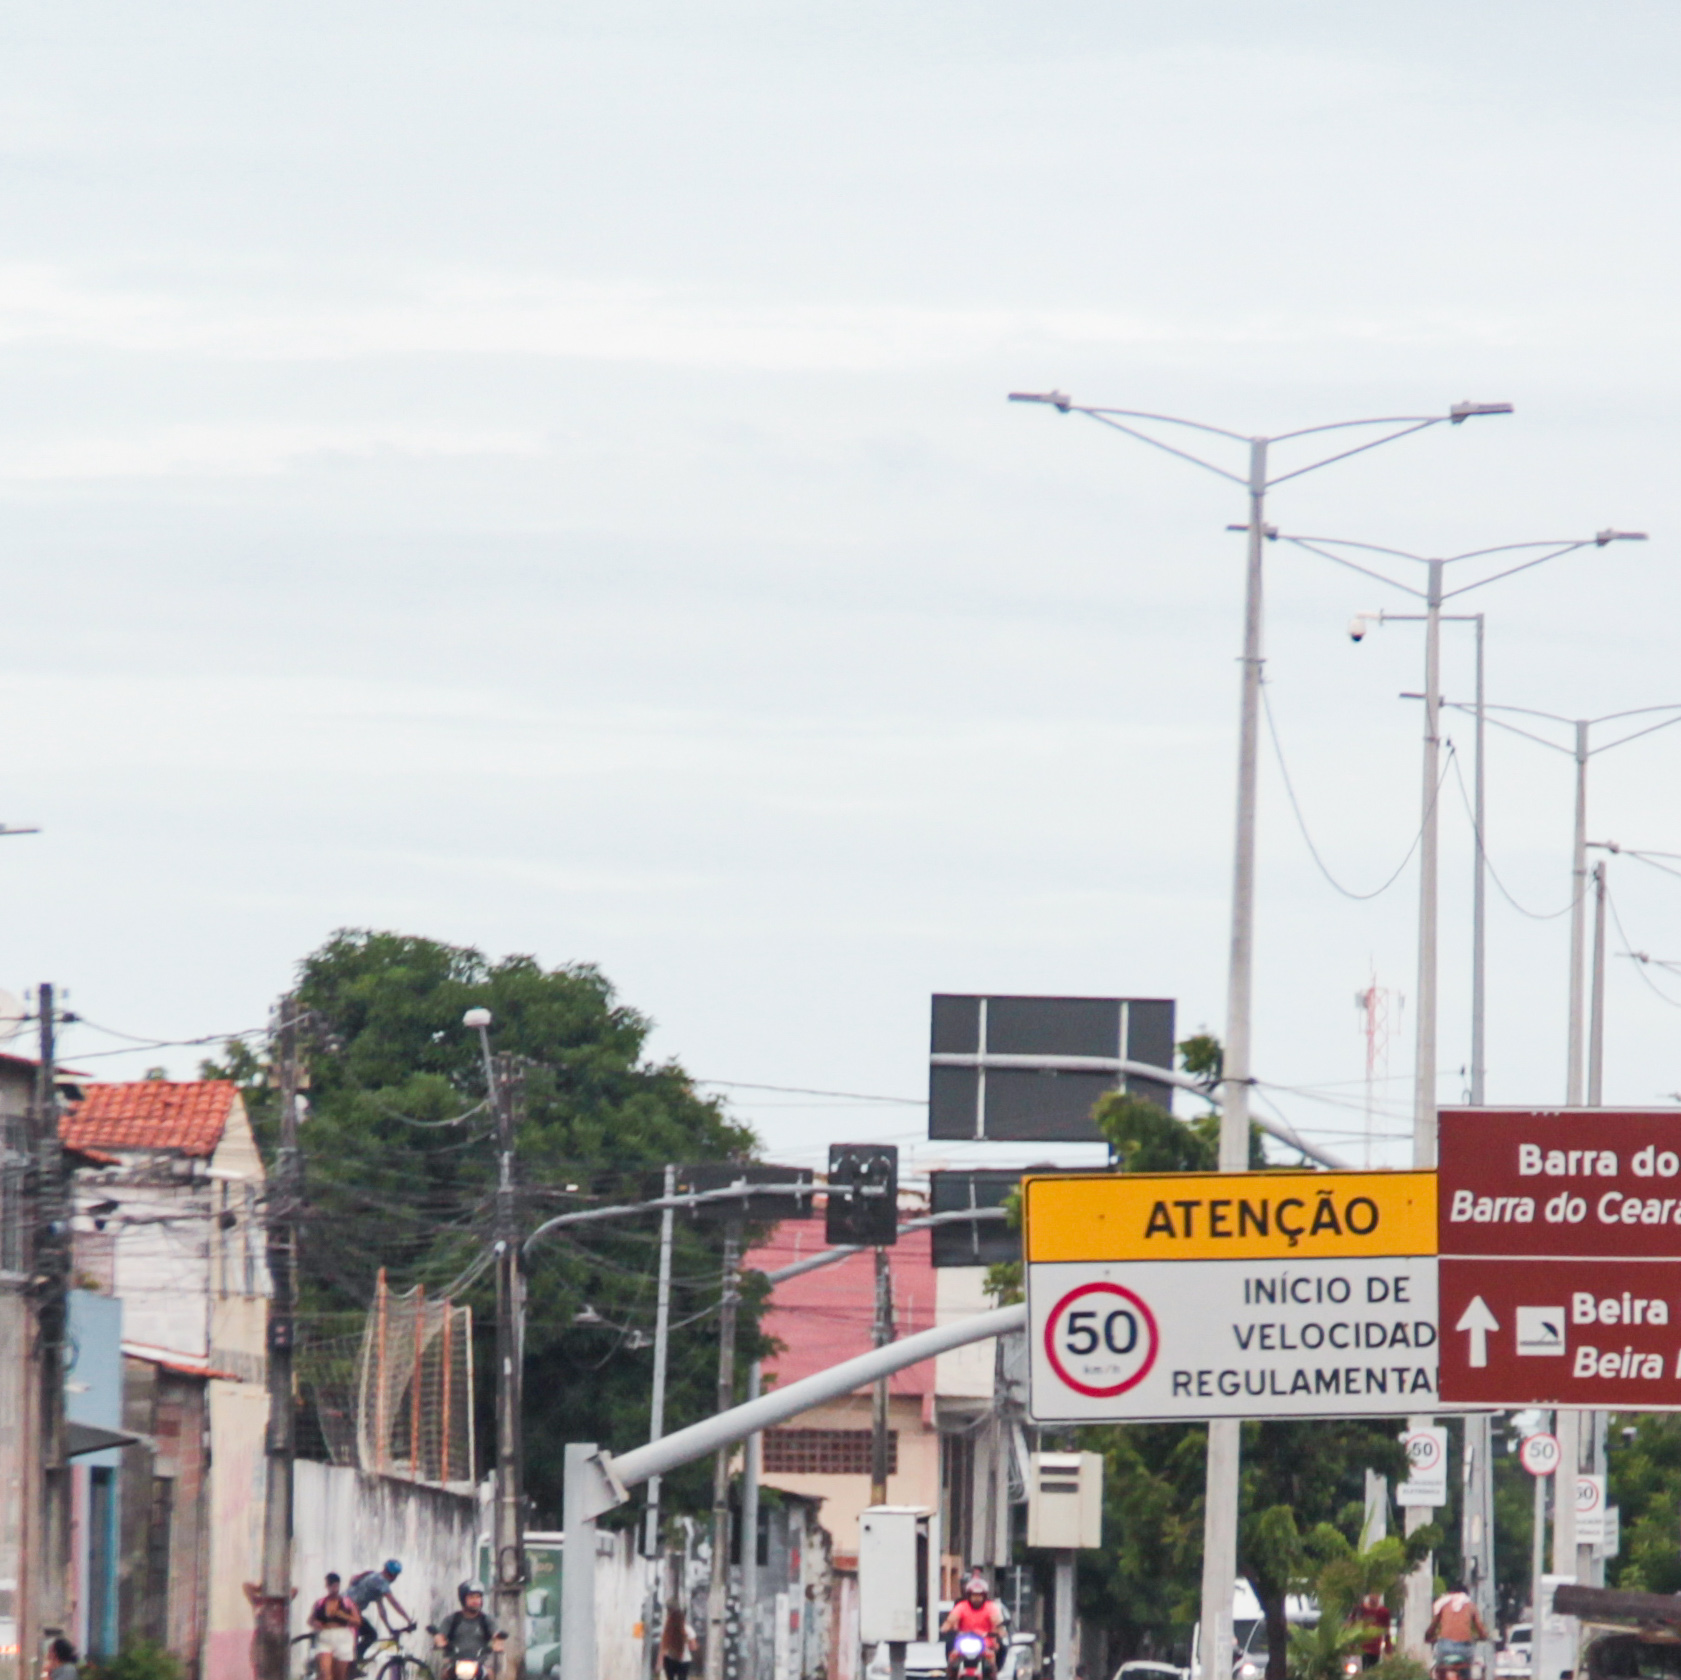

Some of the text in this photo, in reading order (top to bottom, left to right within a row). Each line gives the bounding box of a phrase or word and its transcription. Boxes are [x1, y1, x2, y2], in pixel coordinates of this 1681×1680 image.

[1518, 1143, 1619, 1177] Barra
[1631, 1145, 1680, 1178] do
[1143, 1189, 1380, 1248] ATENÇÃO
[1449, 1189, 1536, 1224] Barra
[1544, 1191, 1587, 1224] do
[1244, 1271, 1411, 1305] INÍCIO DE
[1572, 1292, 1669, 1325] Beira
[1066, 1310, 1139, 1356] 50
[1572, 1346, 1665, 1379] Beira
[1172, 1366, 1439, 1398] REGULAMENTA
[1529, 1442, 1555, 1459] 50
